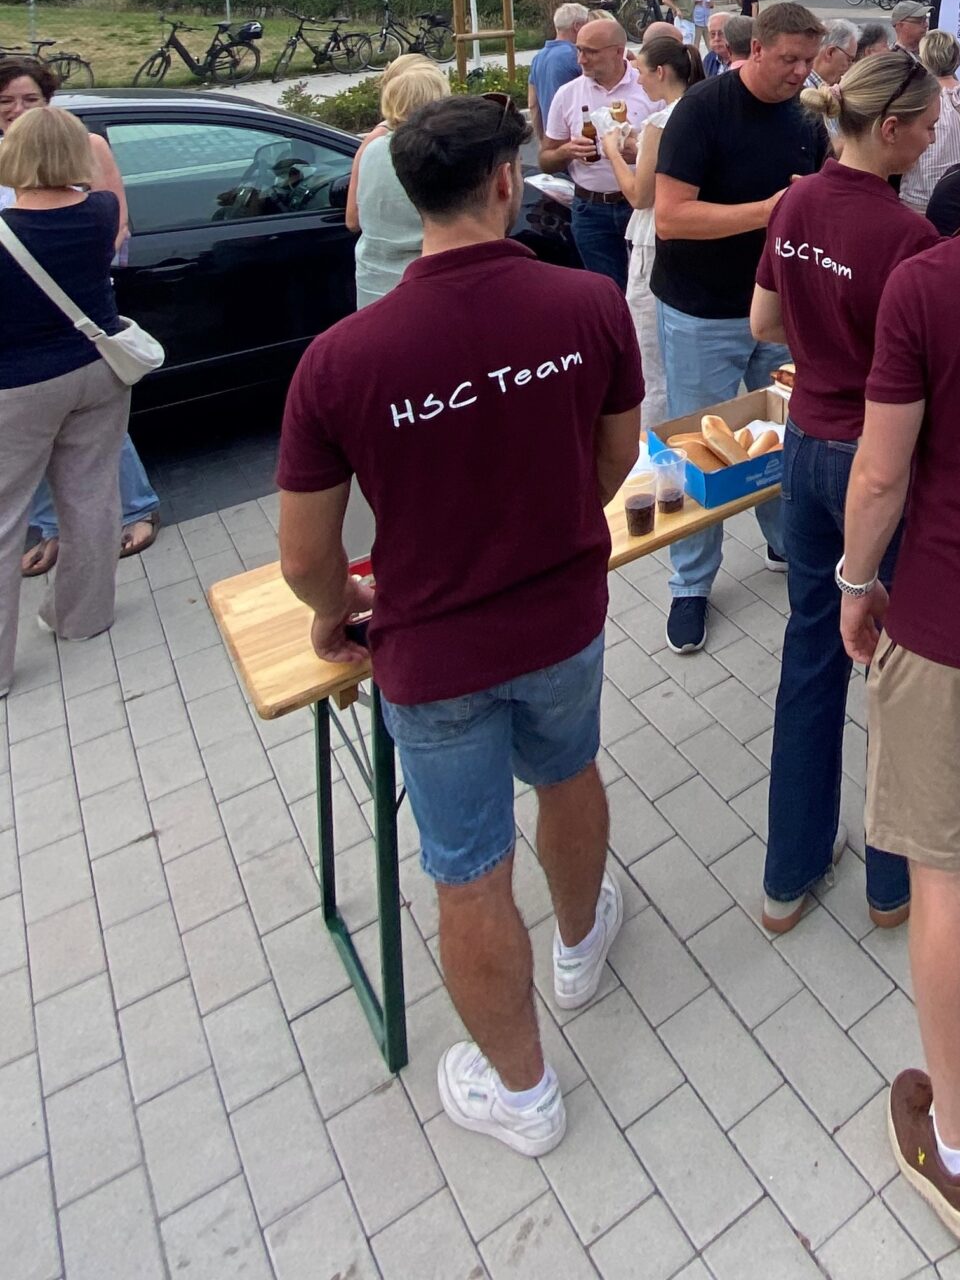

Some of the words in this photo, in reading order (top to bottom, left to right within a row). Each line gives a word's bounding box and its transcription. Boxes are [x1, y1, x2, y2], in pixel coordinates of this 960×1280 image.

[774, 237, 809, 260] HSC
[812, 247, 852, 280] Team
[390, 381, 478, 428] HSC
[488, 351, 583, 393] Team
